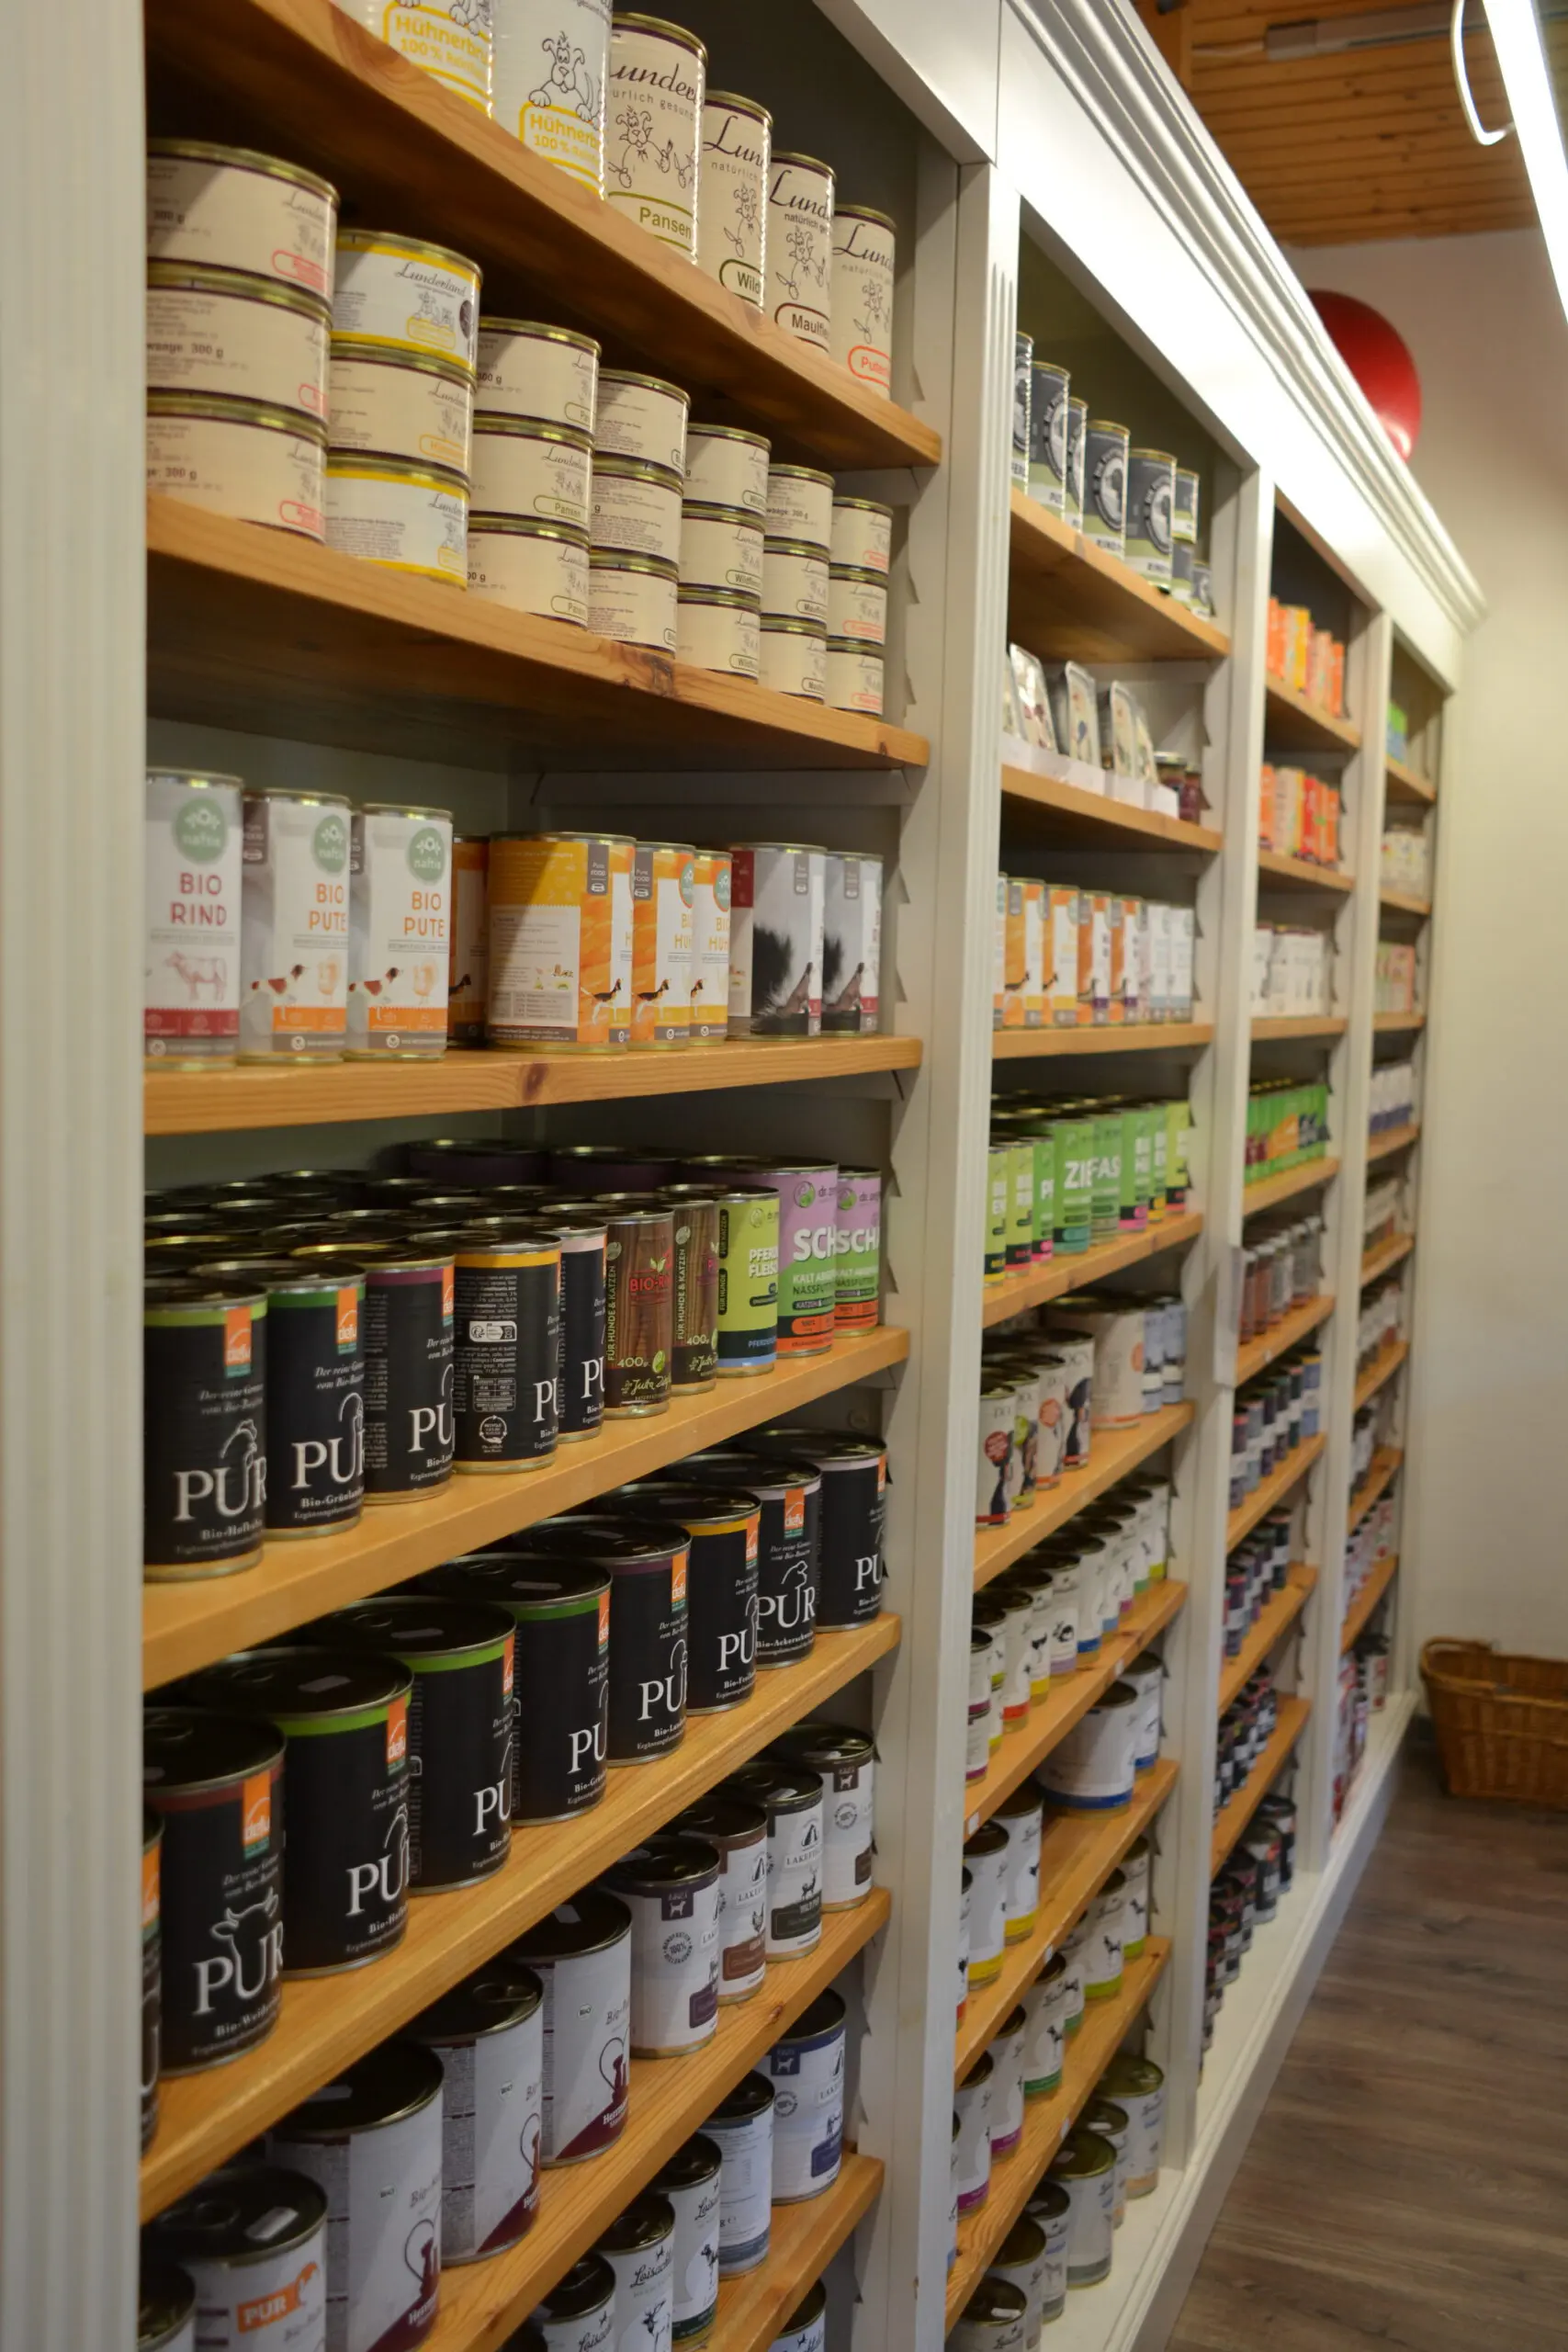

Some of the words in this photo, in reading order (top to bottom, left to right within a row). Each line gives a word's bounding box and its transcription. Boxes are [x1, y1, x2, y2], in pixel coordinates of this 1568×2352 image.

[610, 63, 698, 103] under
[703, 115, 764, 168] Lun
[769, 169, 829, 219] Lund
[639, 206, 692, 241] Pansen
[832, 223, 894, 272] Lund
[179, 872, 223, 897] BIO
[316, 883, 344, 904] BIO
[411, 890, 442, 911] BIO
[169, 901, 228, 927] RIND
[309, 910, 347, 933] PUTE
[403, 916, 446, 938] PUTE
[835, 1226, 881, 1256] SCH
[608, 1311, 616, 1347] HUNDE
[608, 1348, 616, 1362] FÜR
[407, 1402, 455, 1453] PU
[426, 1452, 454, 1469] Bio-Lan
[173, 1455, 267, 1522] PUR
[852, 1553, 883, 1592] PU
[756, 1586, 817, 1632] PUR
[715, 1628, 756, 1673] PU
[637, 1664, 688, 1722] PU
[653, 1715, 687, 1738] Bio-Lan
[192, 1920, 284, 2017] PUR
[243, 2293, 288, 2325] PUR
